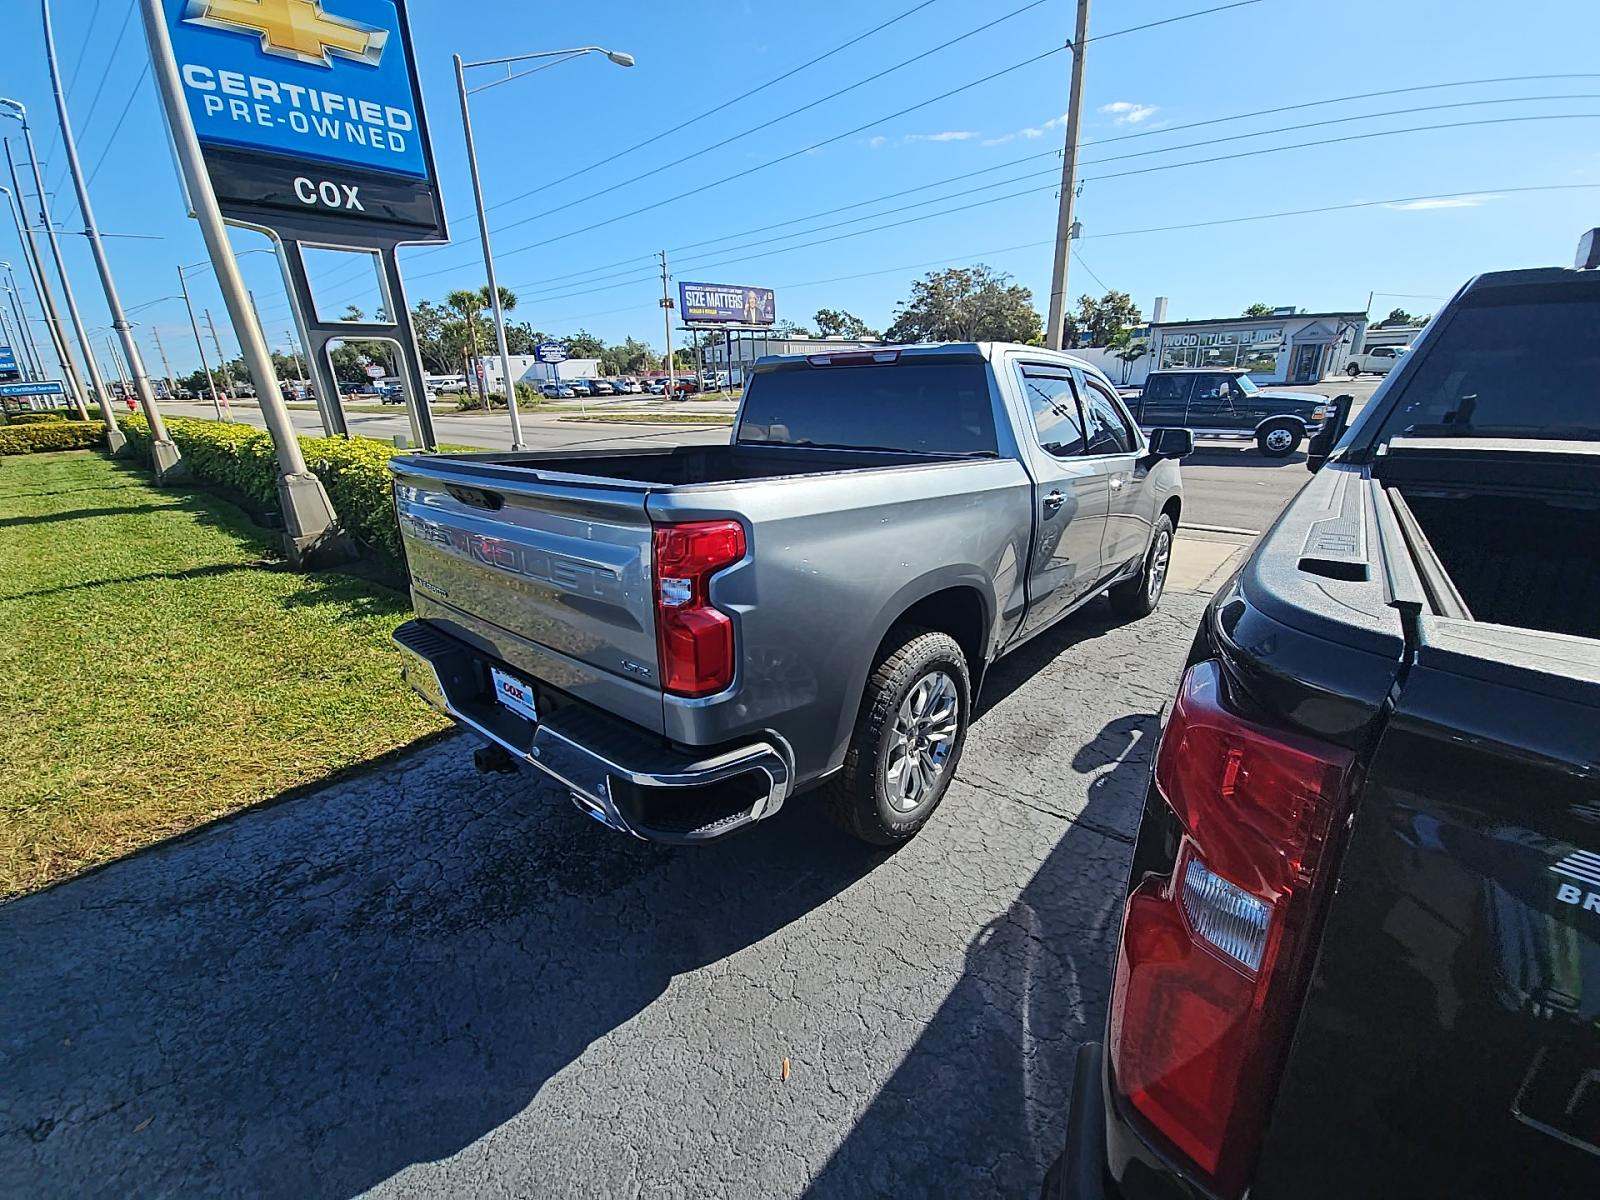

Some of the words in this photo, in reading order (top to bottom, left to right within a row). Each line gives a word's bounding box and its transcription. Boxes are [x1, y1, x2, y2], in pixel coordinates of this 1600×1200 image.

[182, 64, 413, 131] CERTIFIED
[204, 95, 405, 153] PRE-OWNED
[294, 177, 365, 211] COX
[685, 291, 706, 307] SIZE
[706, 292, 743, 309] MATTERS
[1163, 334, 1198, 346] WOOD
[1208, 333, 1232, 345] TILE
[503, 682, 524, 700] COX
